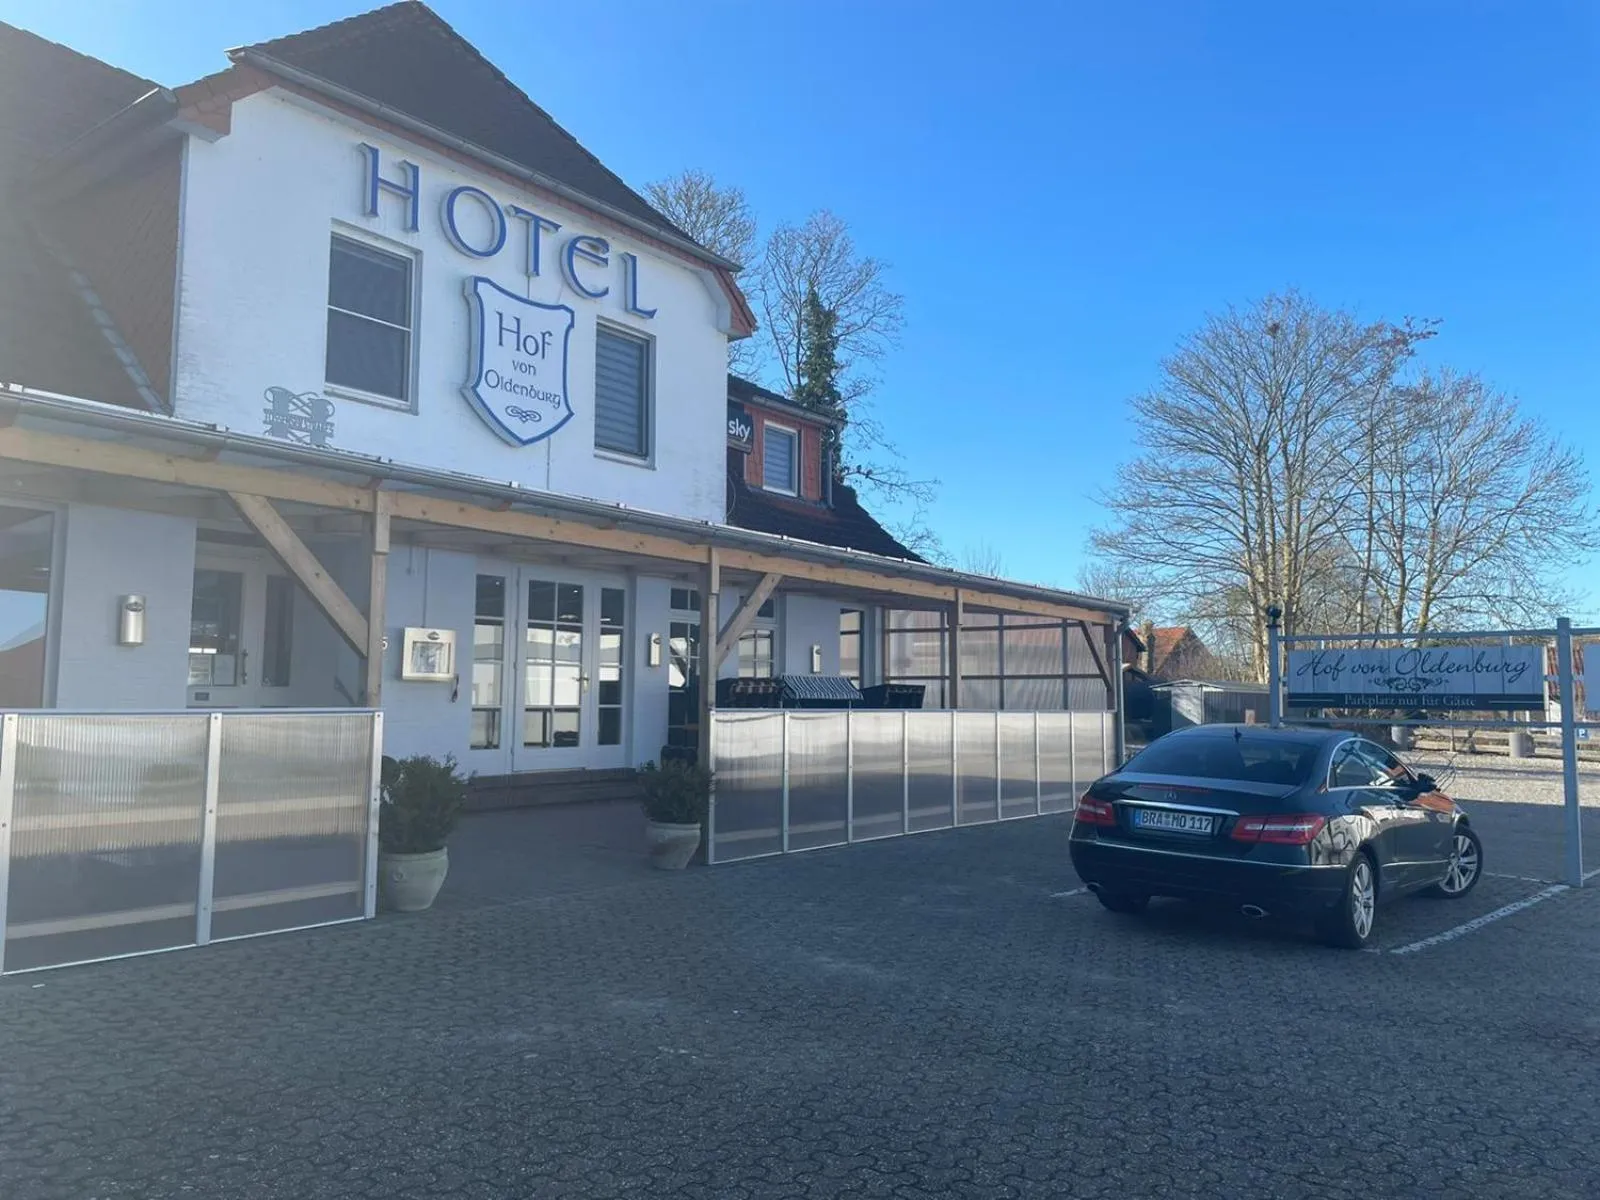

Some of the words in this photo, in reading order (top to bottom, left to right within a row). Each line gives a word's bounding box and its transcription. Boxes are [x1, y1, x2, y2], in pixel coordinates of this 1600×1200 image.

[495, 310, 553, 359] Hof
[511, 359, 537, 376] von
[484, 369, 561, 409] Oldenburg
[728, 418, 751, 442] sky
[1296, 650, 1347, 682] Hof
[1351, 663, 1387, 674] von
[1395, 648, 1529, 683] Oldenburg
[1142, 810, 1163, 826] BRA
